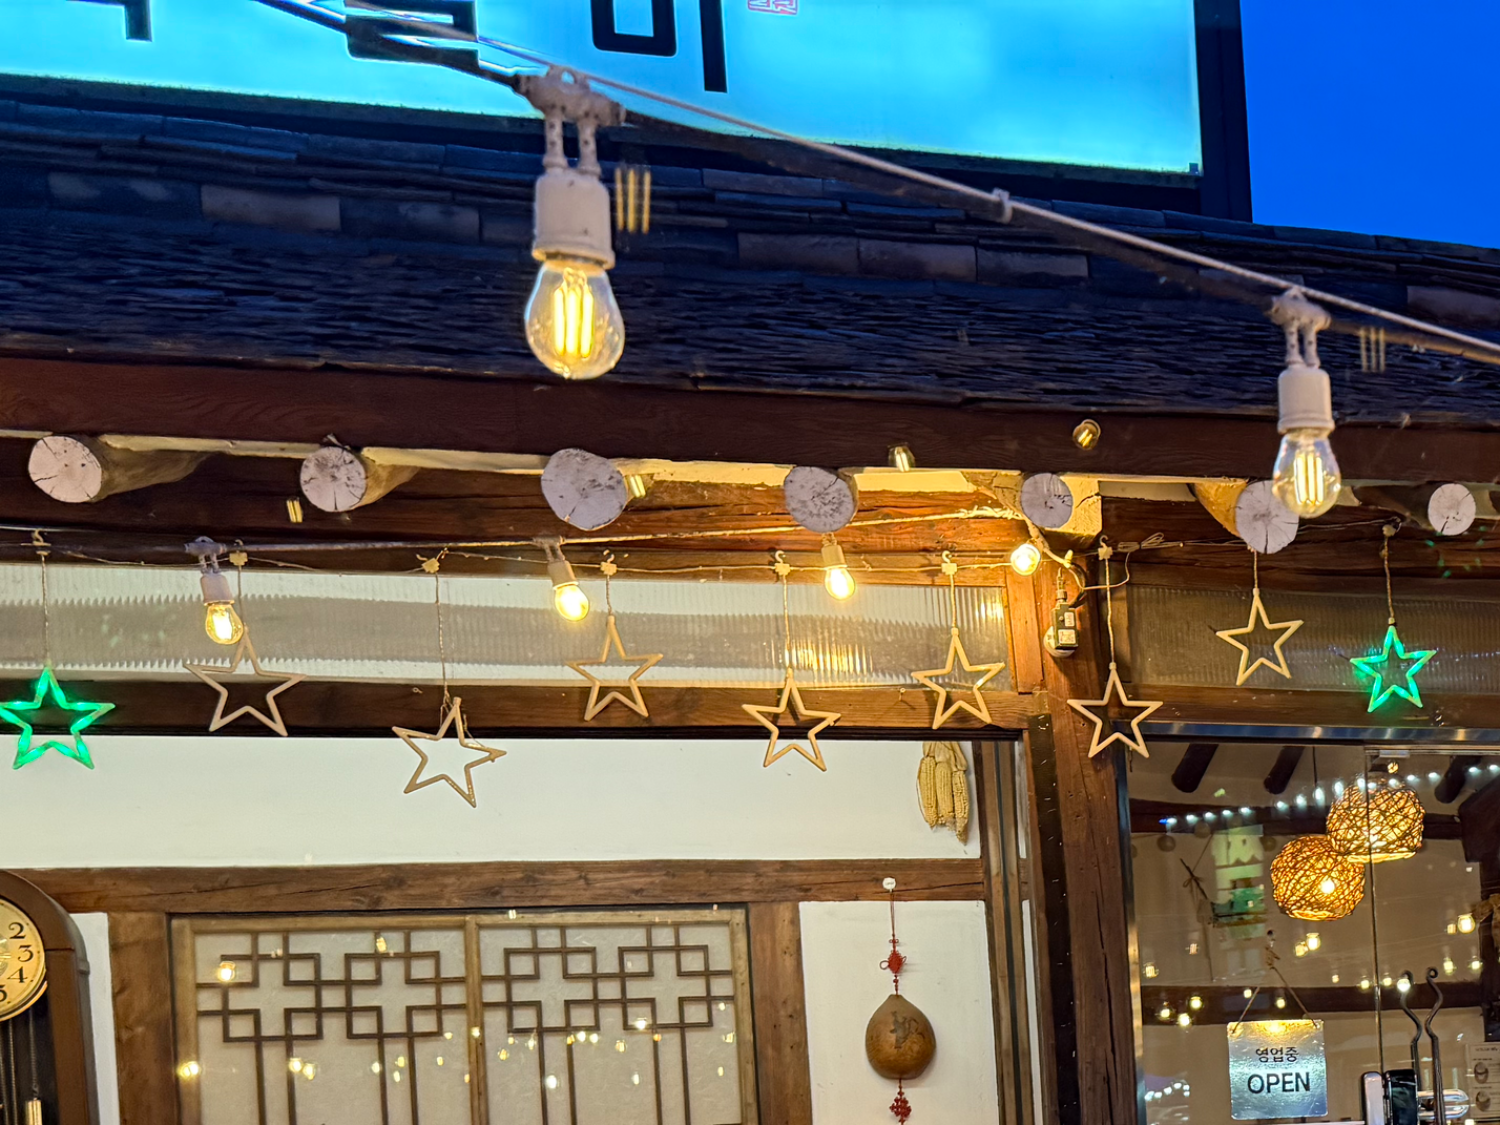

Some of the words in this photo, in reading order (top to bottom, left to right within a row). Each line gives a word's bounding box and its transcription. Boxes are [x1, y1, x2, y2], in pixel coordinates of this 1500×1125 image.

[8, 921, 26, 940] 2
[17, 944, 34, 962] 3
[6, 965, 28, 984] 4
[1255, 1046, 1298, 1063] 영업중
[1247, 1071, 1311, 1094] OPEN
